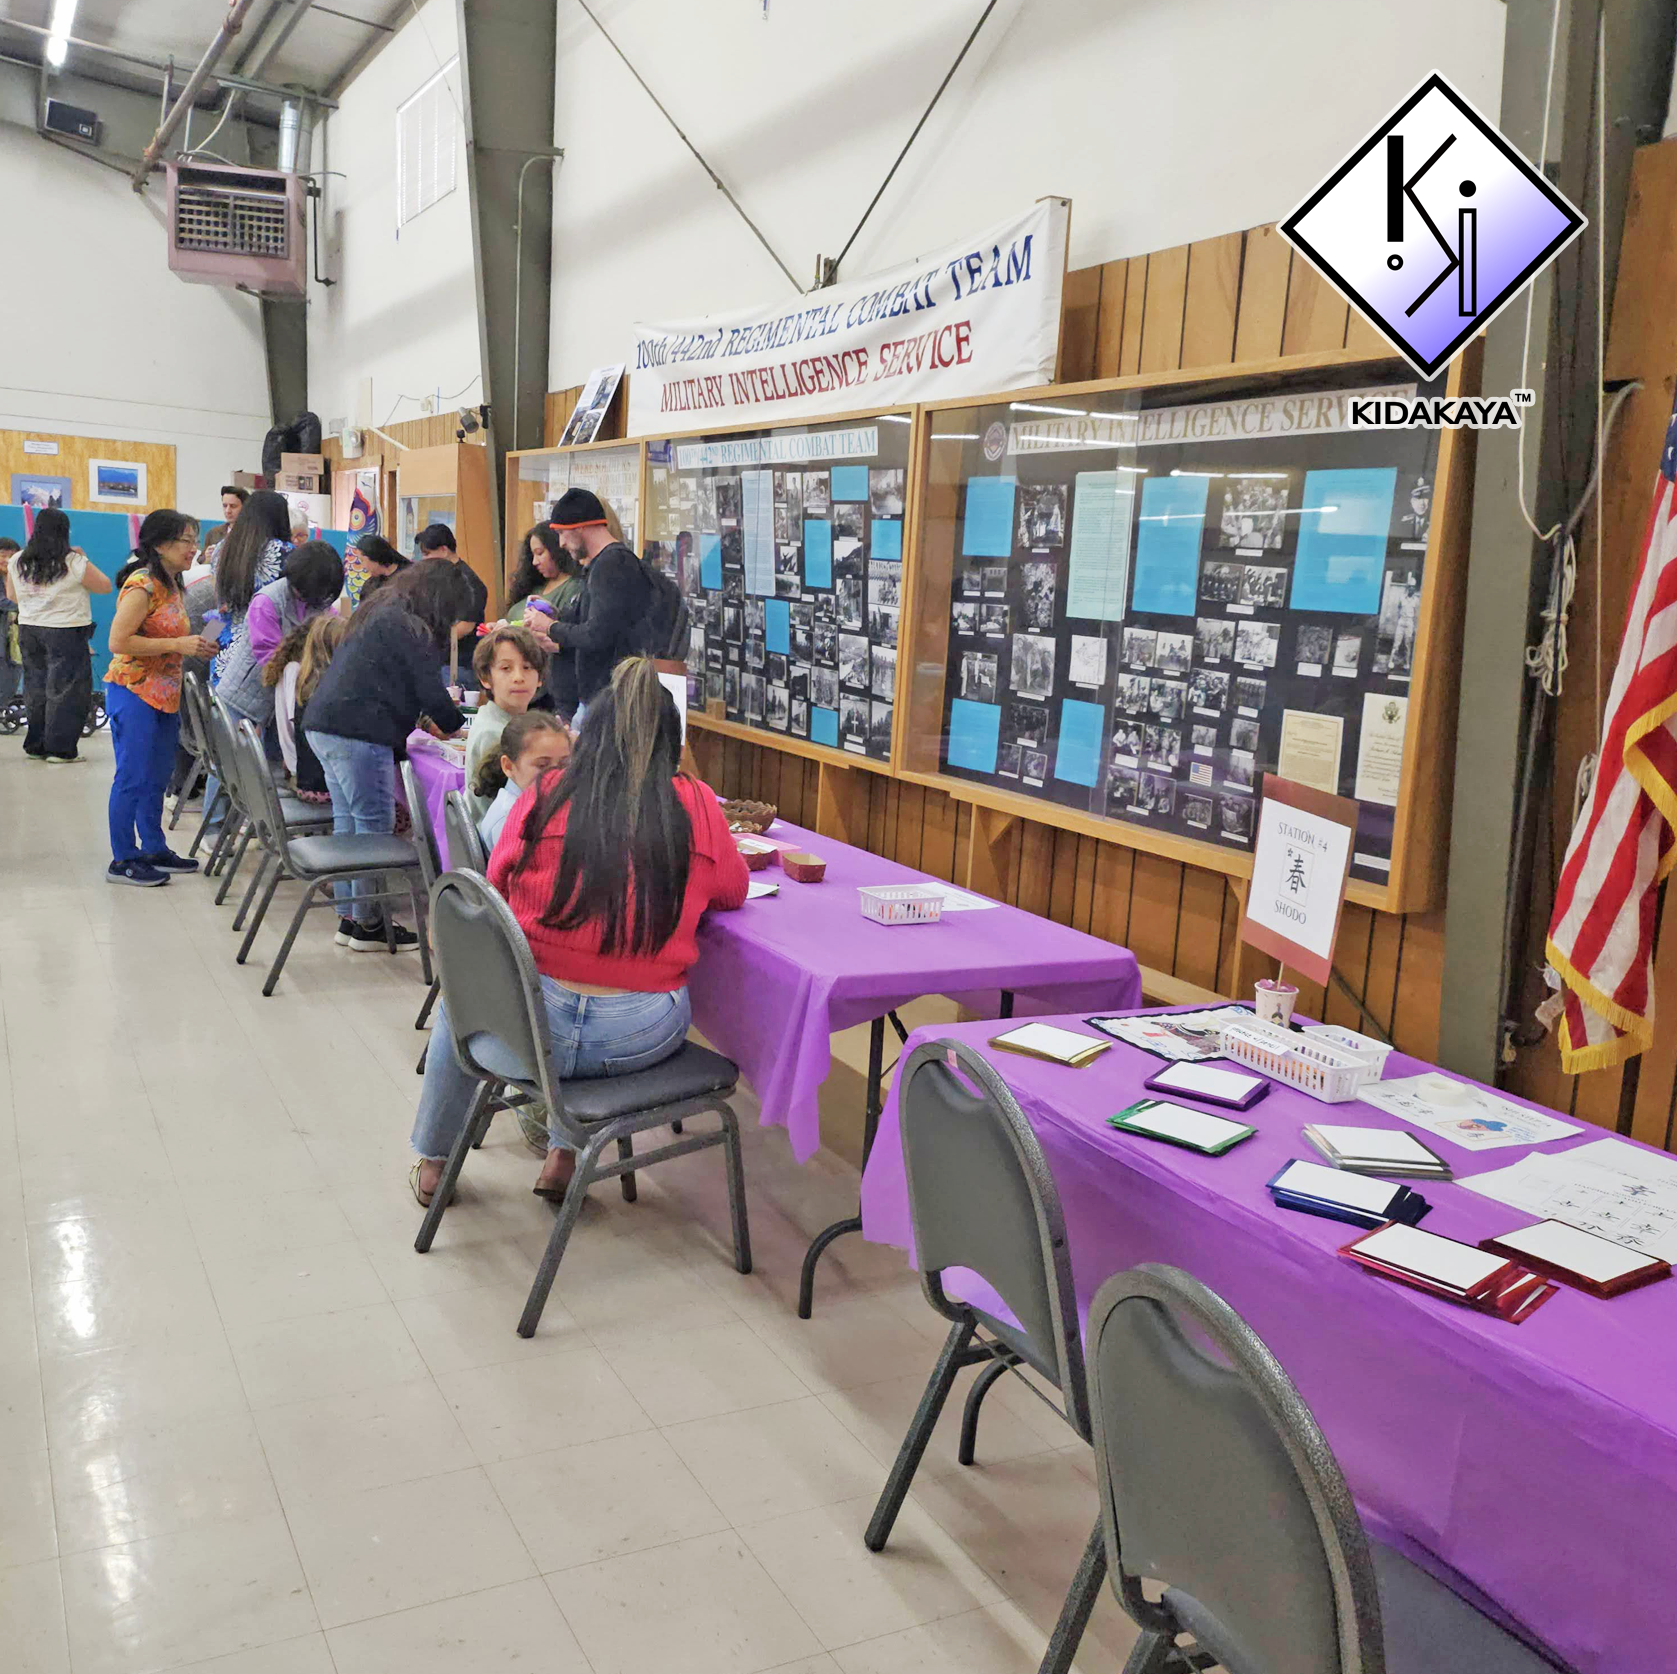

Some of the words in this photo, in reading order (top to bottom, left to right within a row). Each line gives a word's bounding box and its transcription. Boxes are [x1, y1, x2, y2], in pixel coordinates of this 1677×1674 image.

[635, 328, 724, 370] 100th/442nd
[721, 301, 845, 358] REGIMENTAL
[846, 266, 942, 329] COMBAT
[945, 234, 1033, 301] TEAM
[660, 374, 726, 413] MILITARY
[728, 347, 870, 406] INTELLIGENCE
[873, 320, 974, 382] SERVICE
[720, 440, 787, 463] REGIMENTAL
[789, 435, 840, 459] COMBAT
[839, 429, 876, 455] TEAM
[1012, 419, 1103, 451] MILITARY
[1107, 402, 1274, 444] INTELLIGENCE
[1277, 821, 1315, 848] STATION
[1285, 853, 1307, 894] 春
[1274, 900, 1307, 925] SHODO
